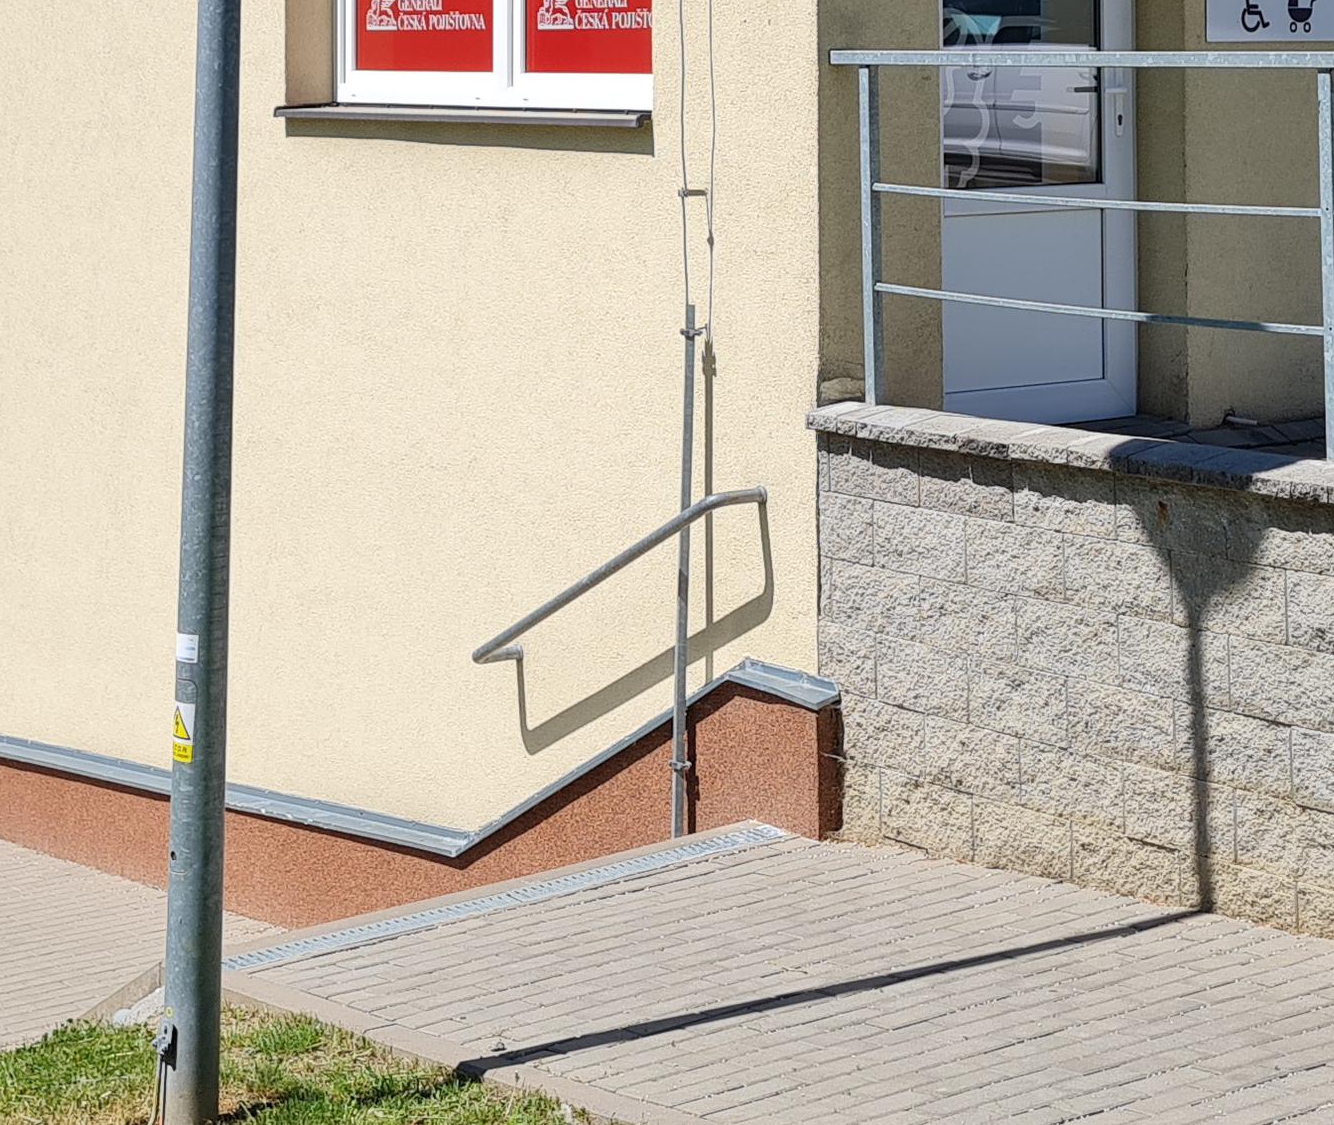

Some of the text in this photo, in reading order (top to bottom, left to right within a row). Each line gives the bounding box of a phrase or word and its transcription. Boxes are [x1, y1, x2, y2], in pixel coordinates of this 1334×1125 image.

[397, 10, 486, 30] ČESKÁ POJIŠŤOVNA
[575, 8, 609, 30] ČESKÁ
